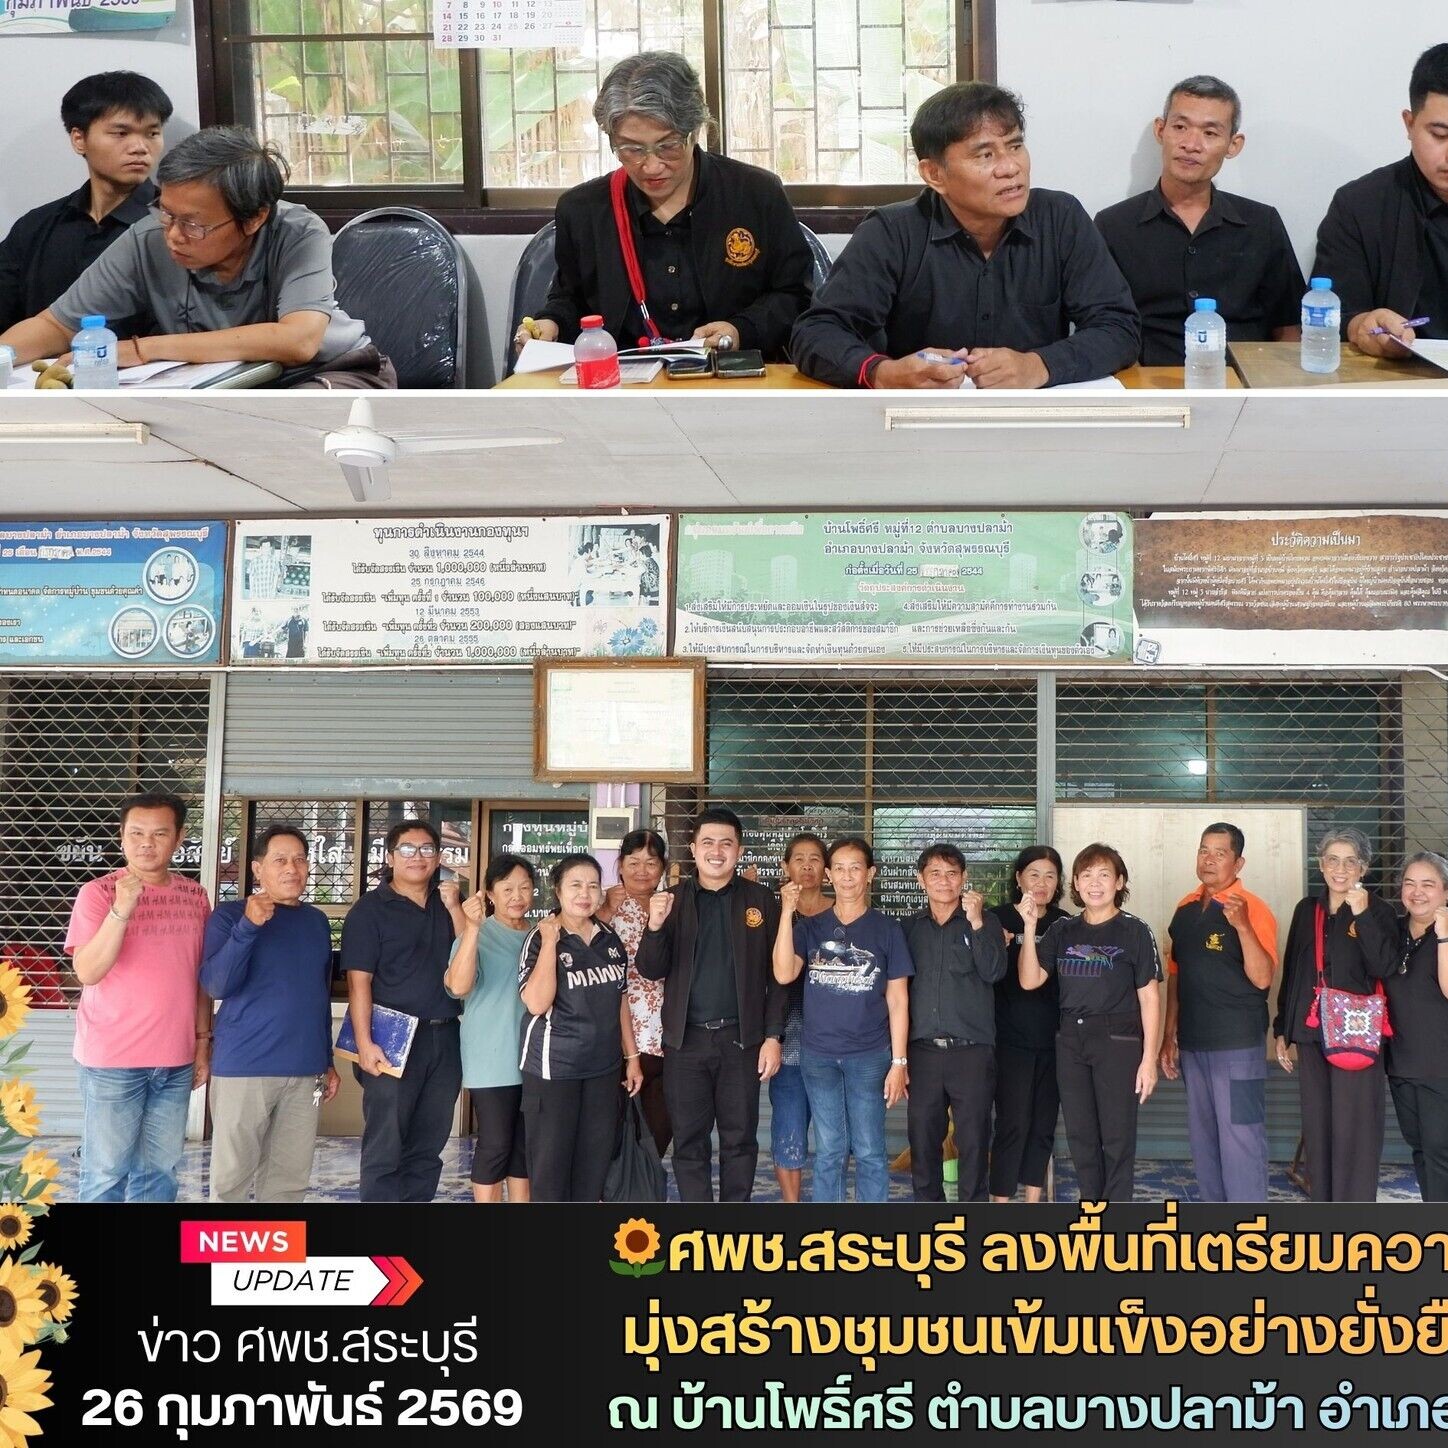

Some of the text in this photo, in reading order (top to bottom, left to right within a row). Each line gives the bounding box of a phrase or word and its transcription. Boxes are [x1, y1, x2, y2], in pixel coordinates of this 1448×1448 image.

[446, 0, 452, 8] 7
[462, 0, 469, 8] 8
[480, 0, 485, 8] 9
[493, 0, 502, 8] 10
[511, 0, 519, 8] 11
[527, 0, 535, 8] 12
[443, 12, 452, 20] 14
[459, 12, 469, 20] 15
[476, 12, 485, 20] 16
[493, 12, 502, 20] 17
[509, 12, 519, 20] 18
[526, 12, 535, 20] 19
[443, 23, 452, 31] 21
[457, 23, 469, 31] 22
[474, 23, 485, 31] 23
[491, 23, 502, 31] 24
[524, 23, 535, 31] 26
[823, 519, 879, 534] บ้านโพธิ์ศรี
[926, 519, 1013, 534] ตำบลบางปลาม้า
[373, 523, 529, 544] ทุนการดำเนินงานกองทุนฯ
[1270, 530, 1361, 547] ประวัติความเป็นมา
[409, 547, 485, 558] 30 สิงหาคม 2544
[824, 541, 1010, 558] อำเภอบางปลาม้า จังหวัดสุพรรณบุรี
[408, 562, 433, 573] จำนวน
[436, 562, 487, 573] 1,000,000
[906, 566, 918, 575] 25
[961, 566, 983, 575] 2544
[424, 576, 462, 588] กรกฎาคม
[465, 577, 485, 586] 2546
[441, 590, 470, 602] จำนวน
[473, 591, 514, 603] 100,000
[415, 606, 480, 616] 12 มีนาคม 2553
[439, 620, 468, 631] จำนวน
[470, 620, 512, 631] 200,000
[427, 634, 456, 646] ตุลาคม
[459, 635, 478, 644] 2555
[434, 646, 462, 657] จำนวน
[466, 646, 517, 657] 1,000,000
[56, 835, 103, 862] ขยัน
